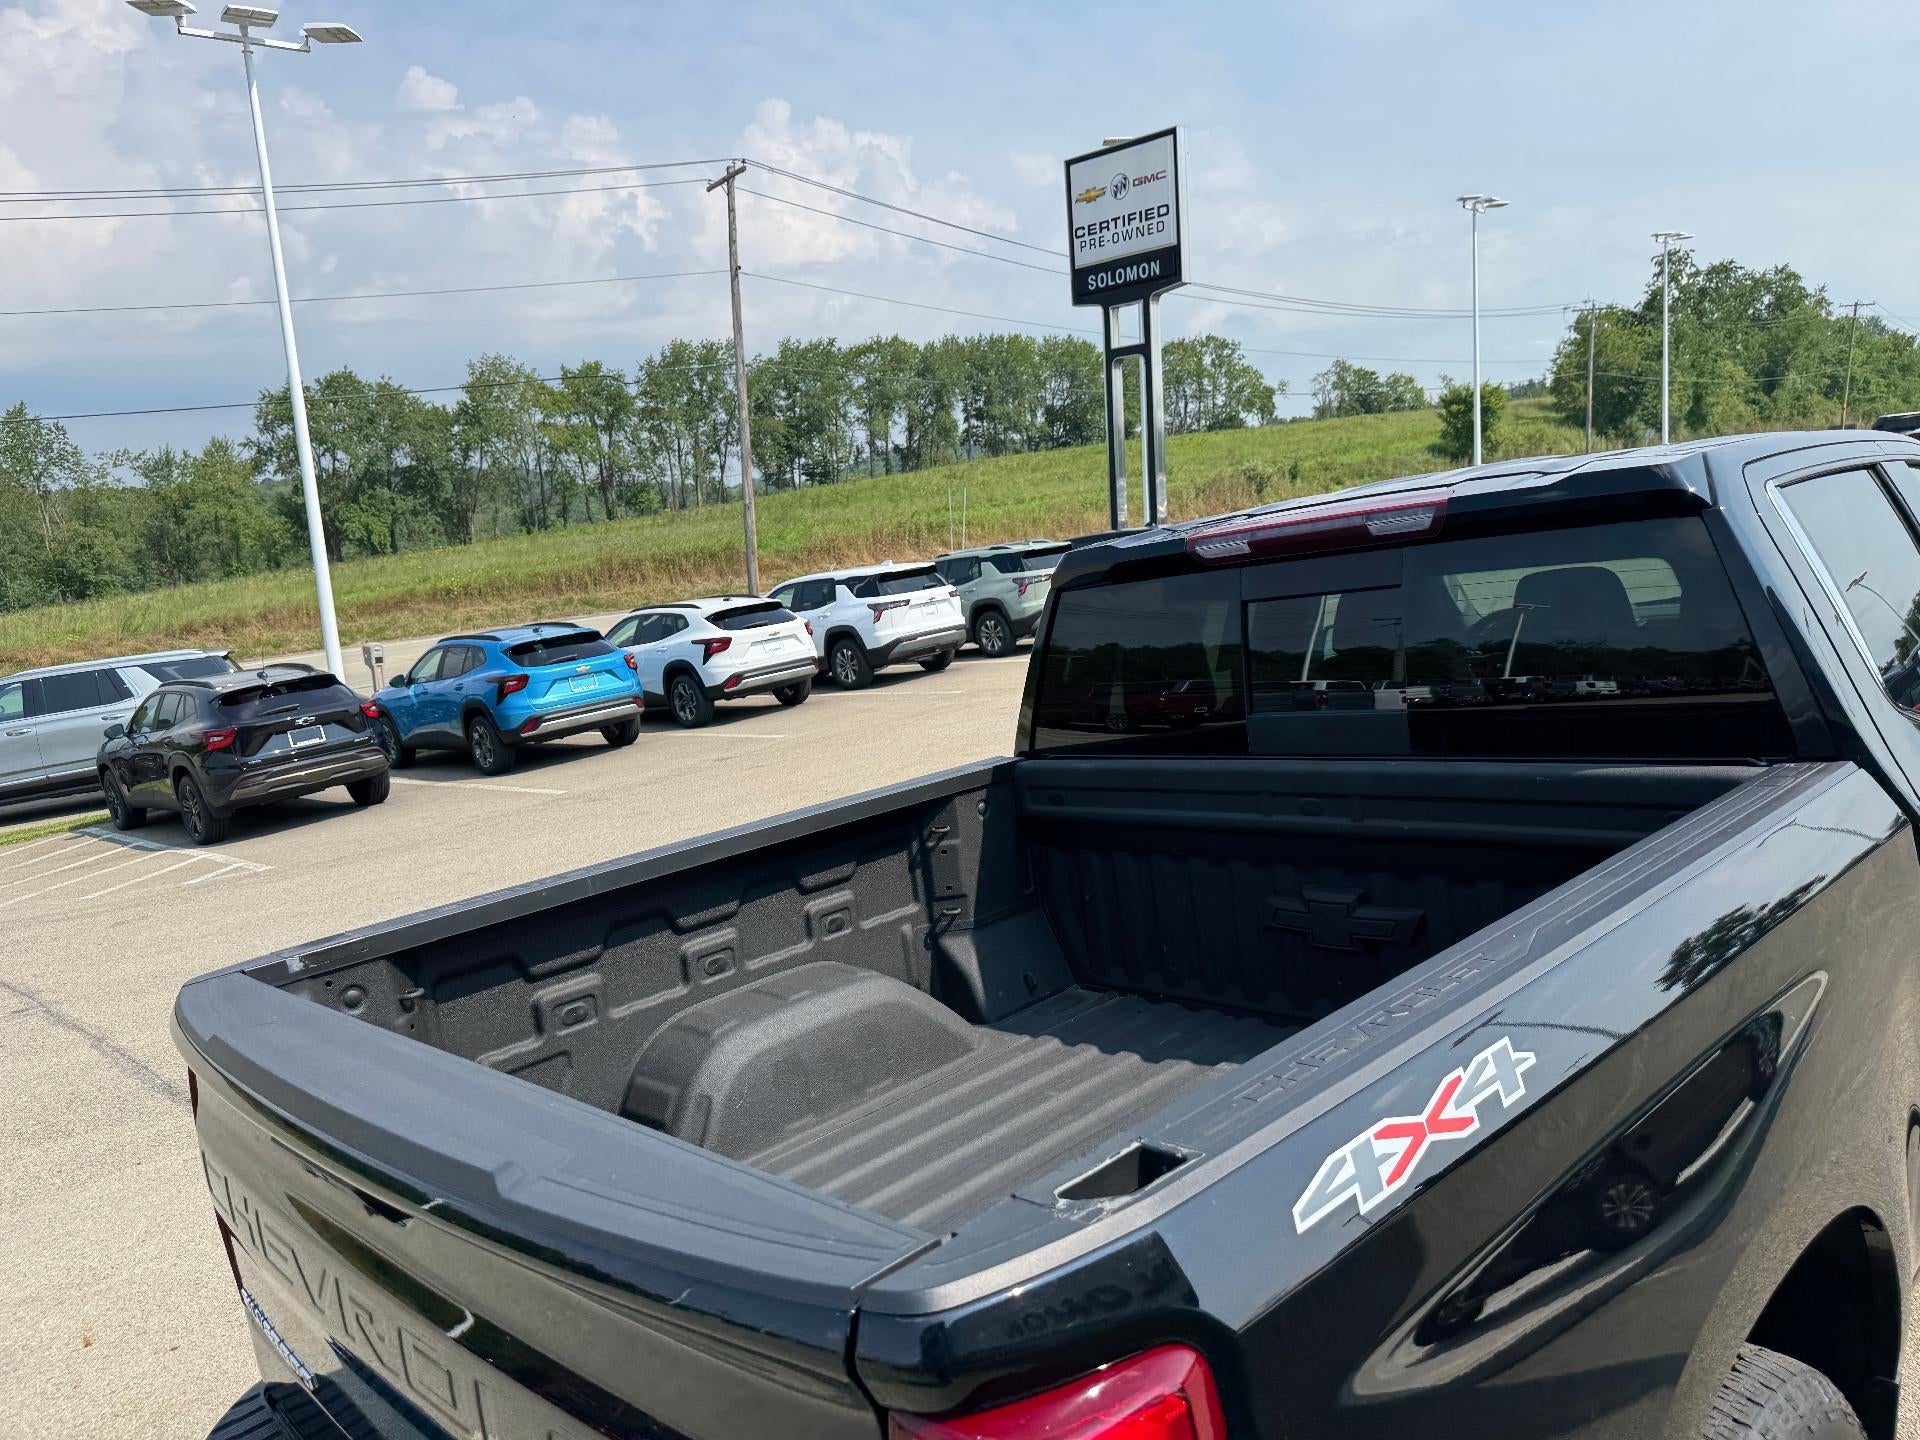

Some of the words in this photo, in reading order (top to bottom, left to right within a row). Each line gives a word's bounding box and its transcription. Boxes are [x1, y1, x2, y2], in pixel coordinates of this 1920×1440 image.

[1132, 170, 1167, 187] GMC
[1074, 203, 1170, 239] CERTIFIED
[1080, 220, 1165, 252] PRE-OWNED
[1087, 259, 1160, 291] SOLOMON
[1292, 1035, 1537, 1235] 4X4
[200, 1149, 566, 1440] CHEVROL
